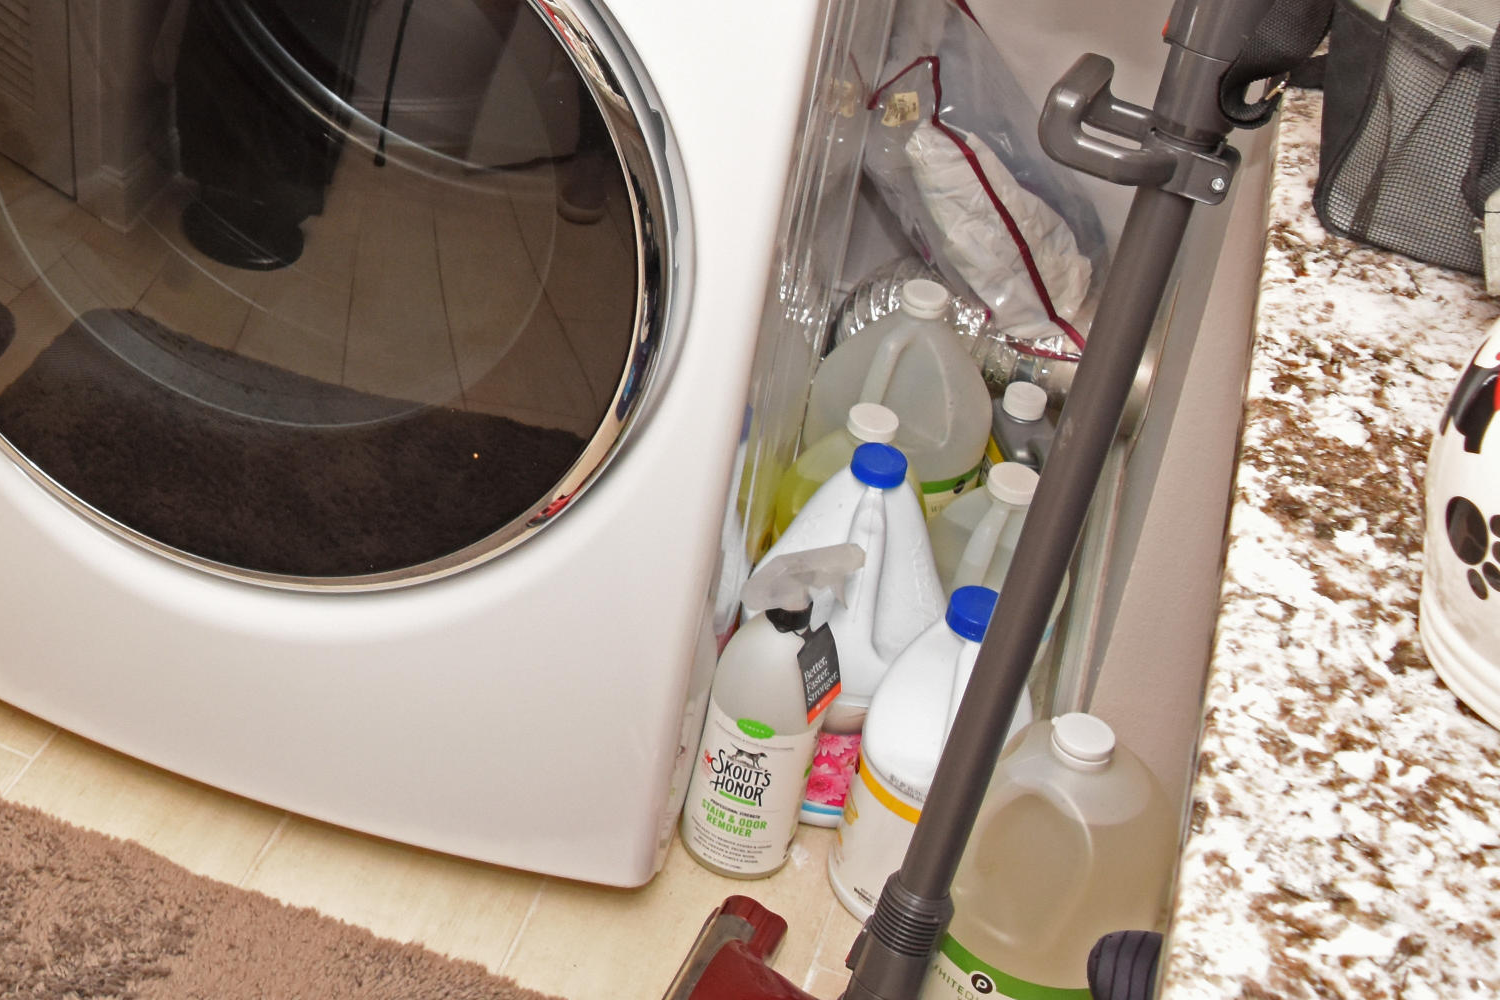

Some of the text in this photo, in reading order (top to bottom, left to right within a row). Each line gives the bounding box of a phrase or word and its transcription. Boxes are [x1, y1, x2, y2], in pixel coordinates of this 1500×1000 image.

[804, 656, 828, 683] Better,
[806, 668, 830, 694] Faster,
[711, 749, 772, 787] SKOUT'S
[710, 775, 764, 807] HONOR
[702, 798, 768, 830] STAIN & ODOR
[706, 814, 752, 838] REMOVER
